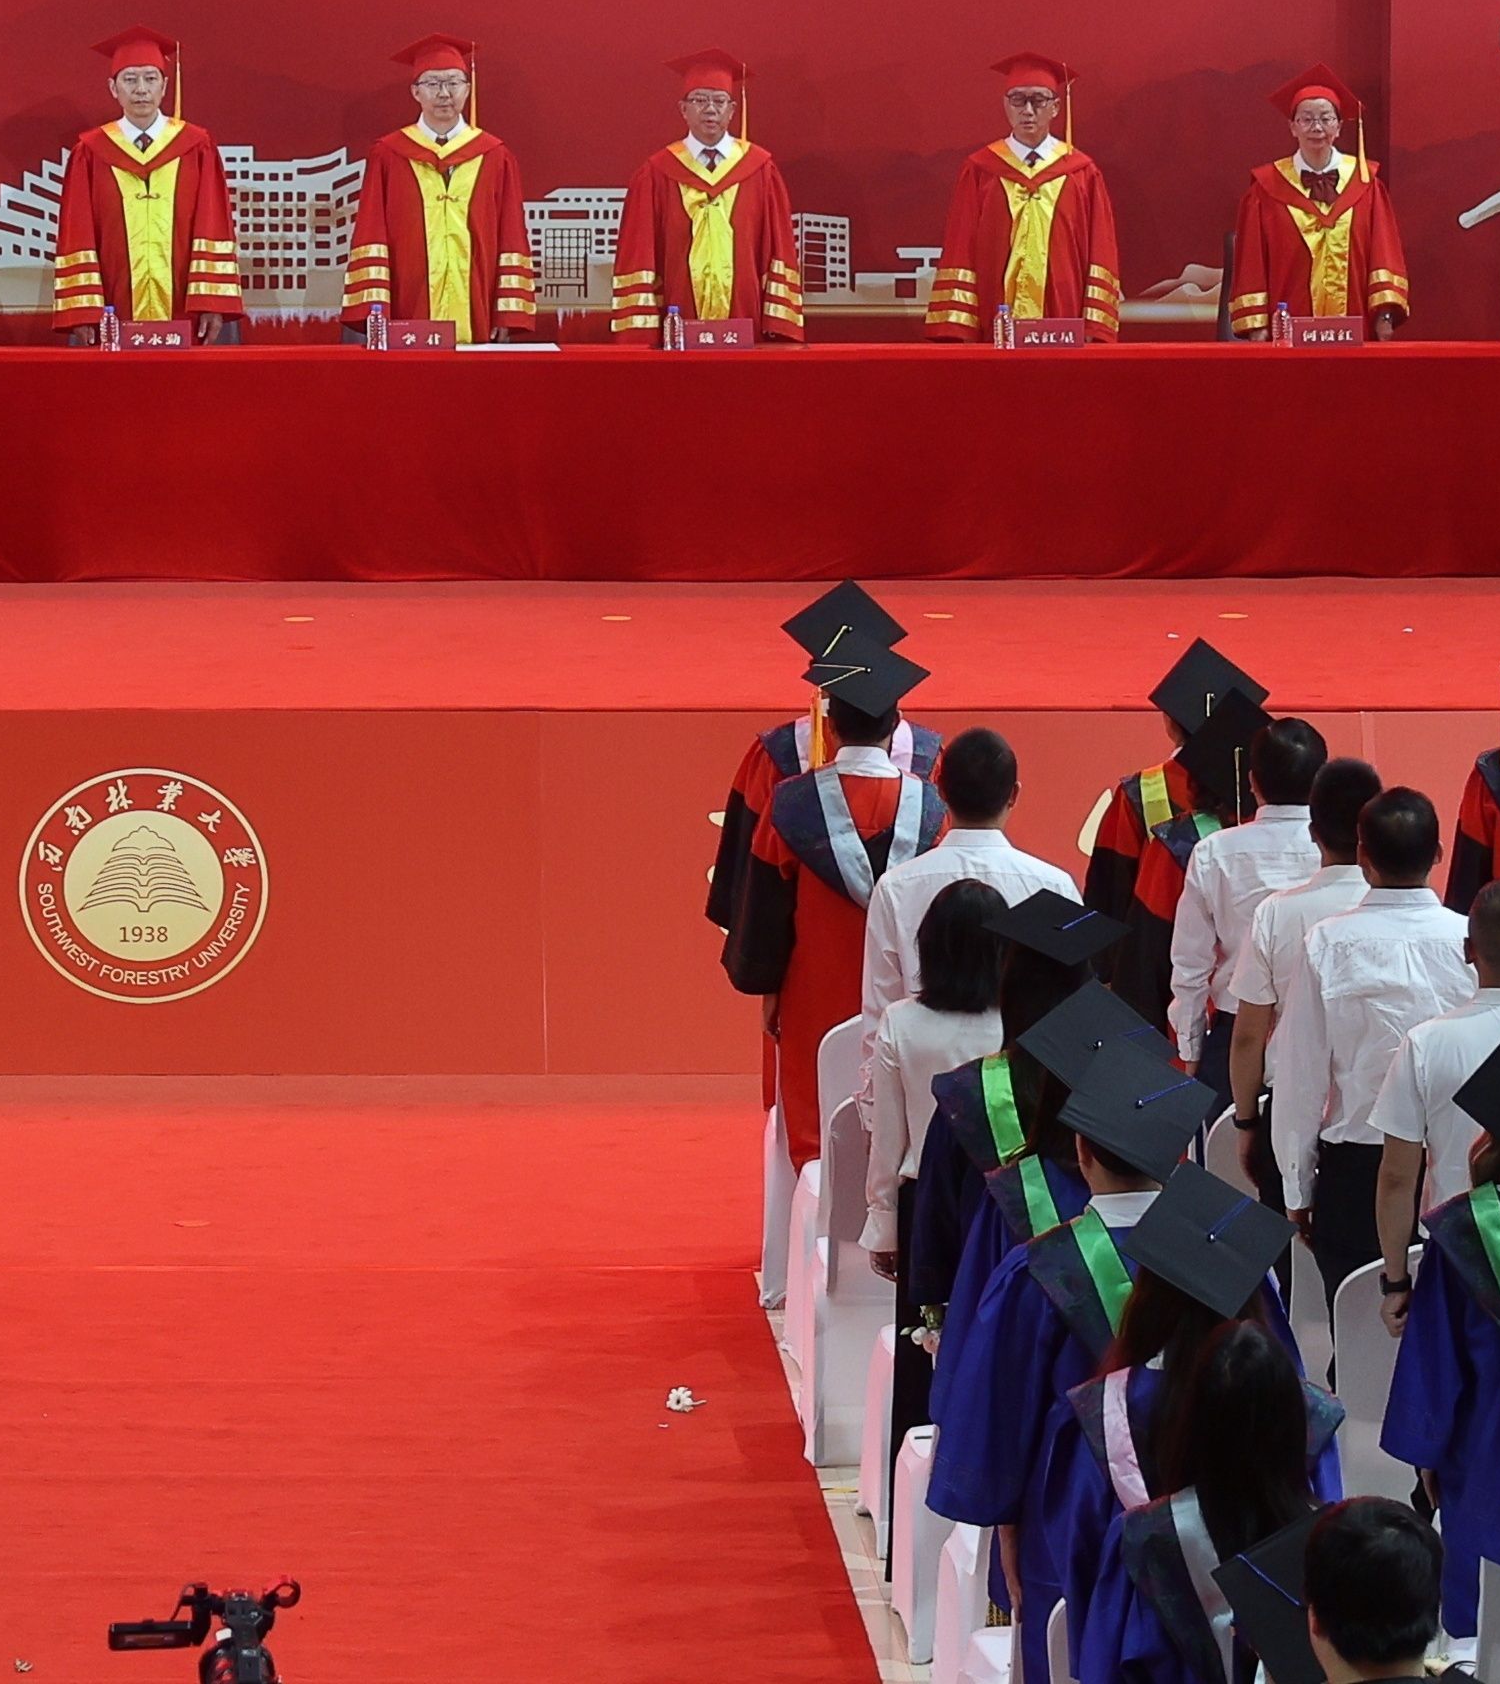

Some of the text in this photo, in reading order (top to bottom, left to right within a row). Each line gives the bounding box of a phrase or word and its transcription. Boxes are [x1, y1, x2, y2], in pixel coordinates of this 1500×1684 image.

[37, 882, 251, 985] SOUTHWEST FORESTRY UNIVERSITY
[119, 926, 169, 943] 1938
